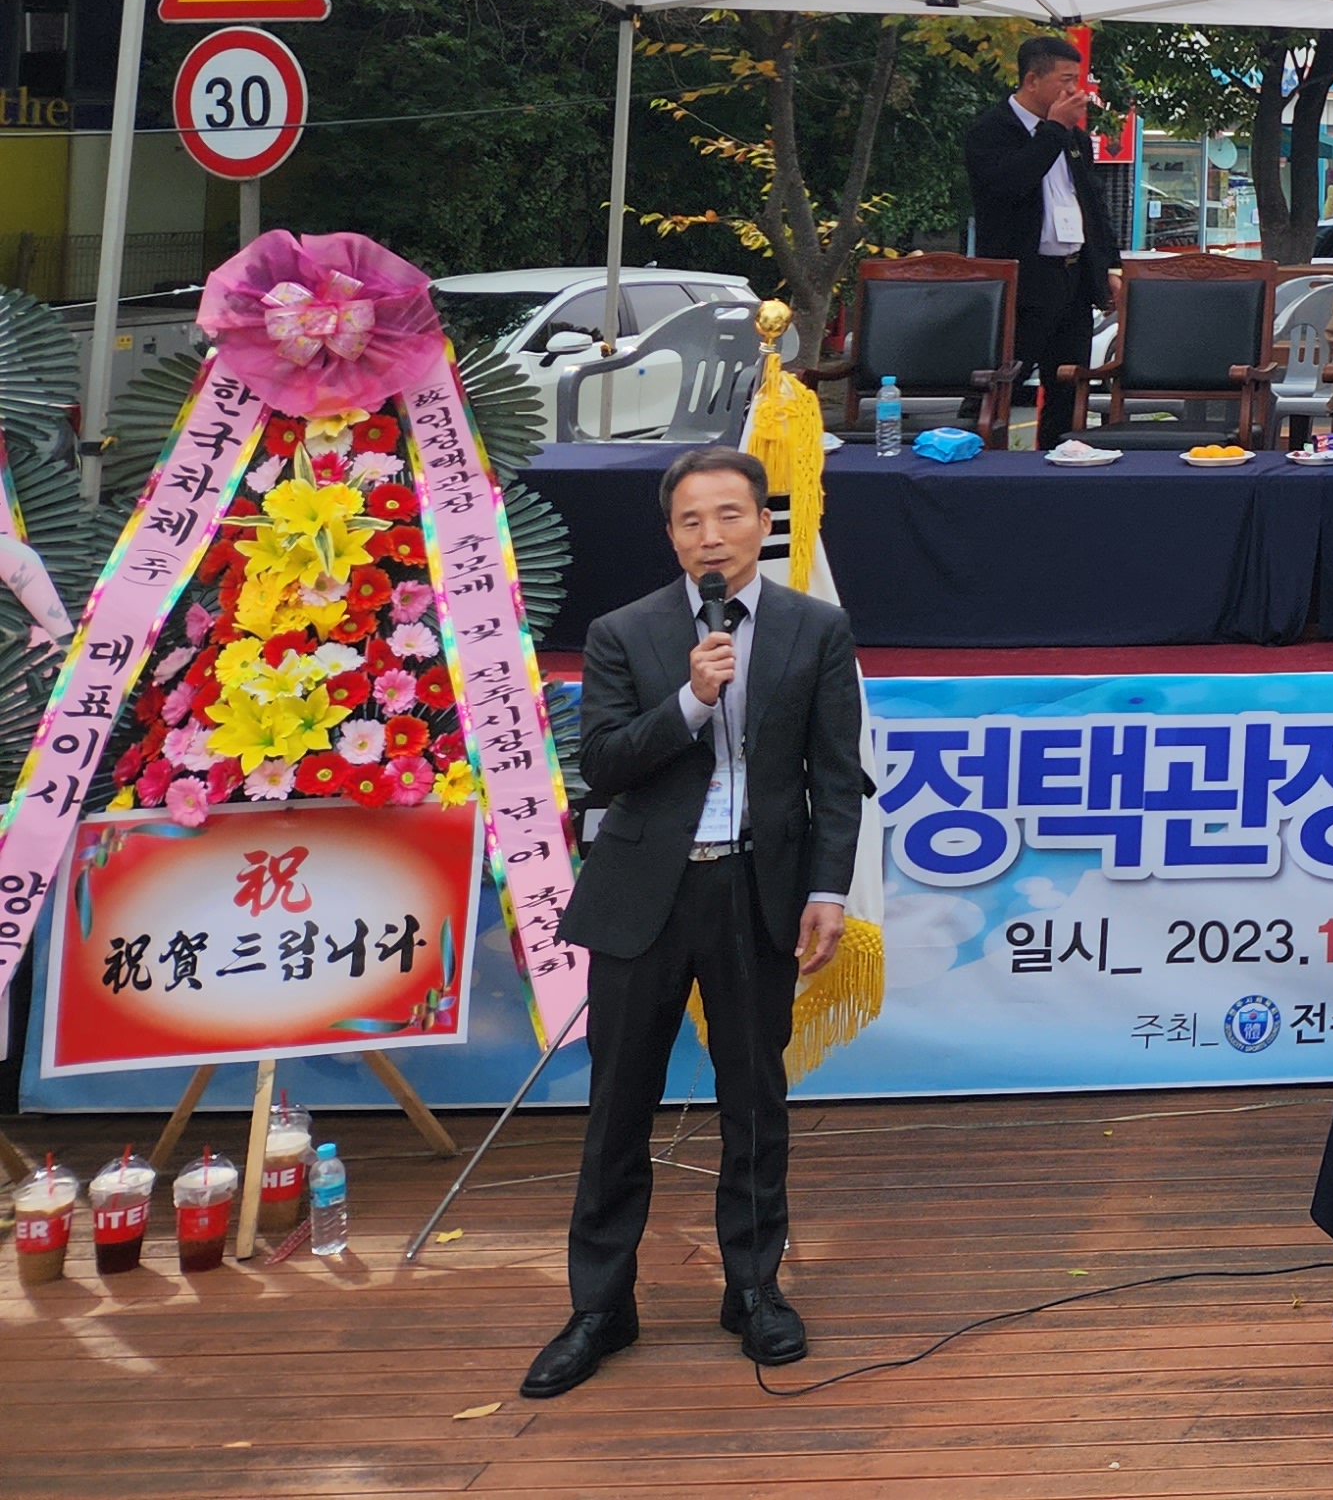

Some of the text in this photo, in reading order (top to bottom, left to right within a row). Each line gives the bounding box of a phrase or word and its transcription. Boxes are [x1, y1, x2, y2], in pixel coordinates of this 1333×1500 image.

[205, 75, 271, 129] 30
[443, 533, 499, 597] 추모배
[27, 634, 133, 818] 대표이사
[466, 661, 534, 773] 전주시장배
[233, 846, 312, 918] 祝
[262, 1168, 296, 1189] HE
